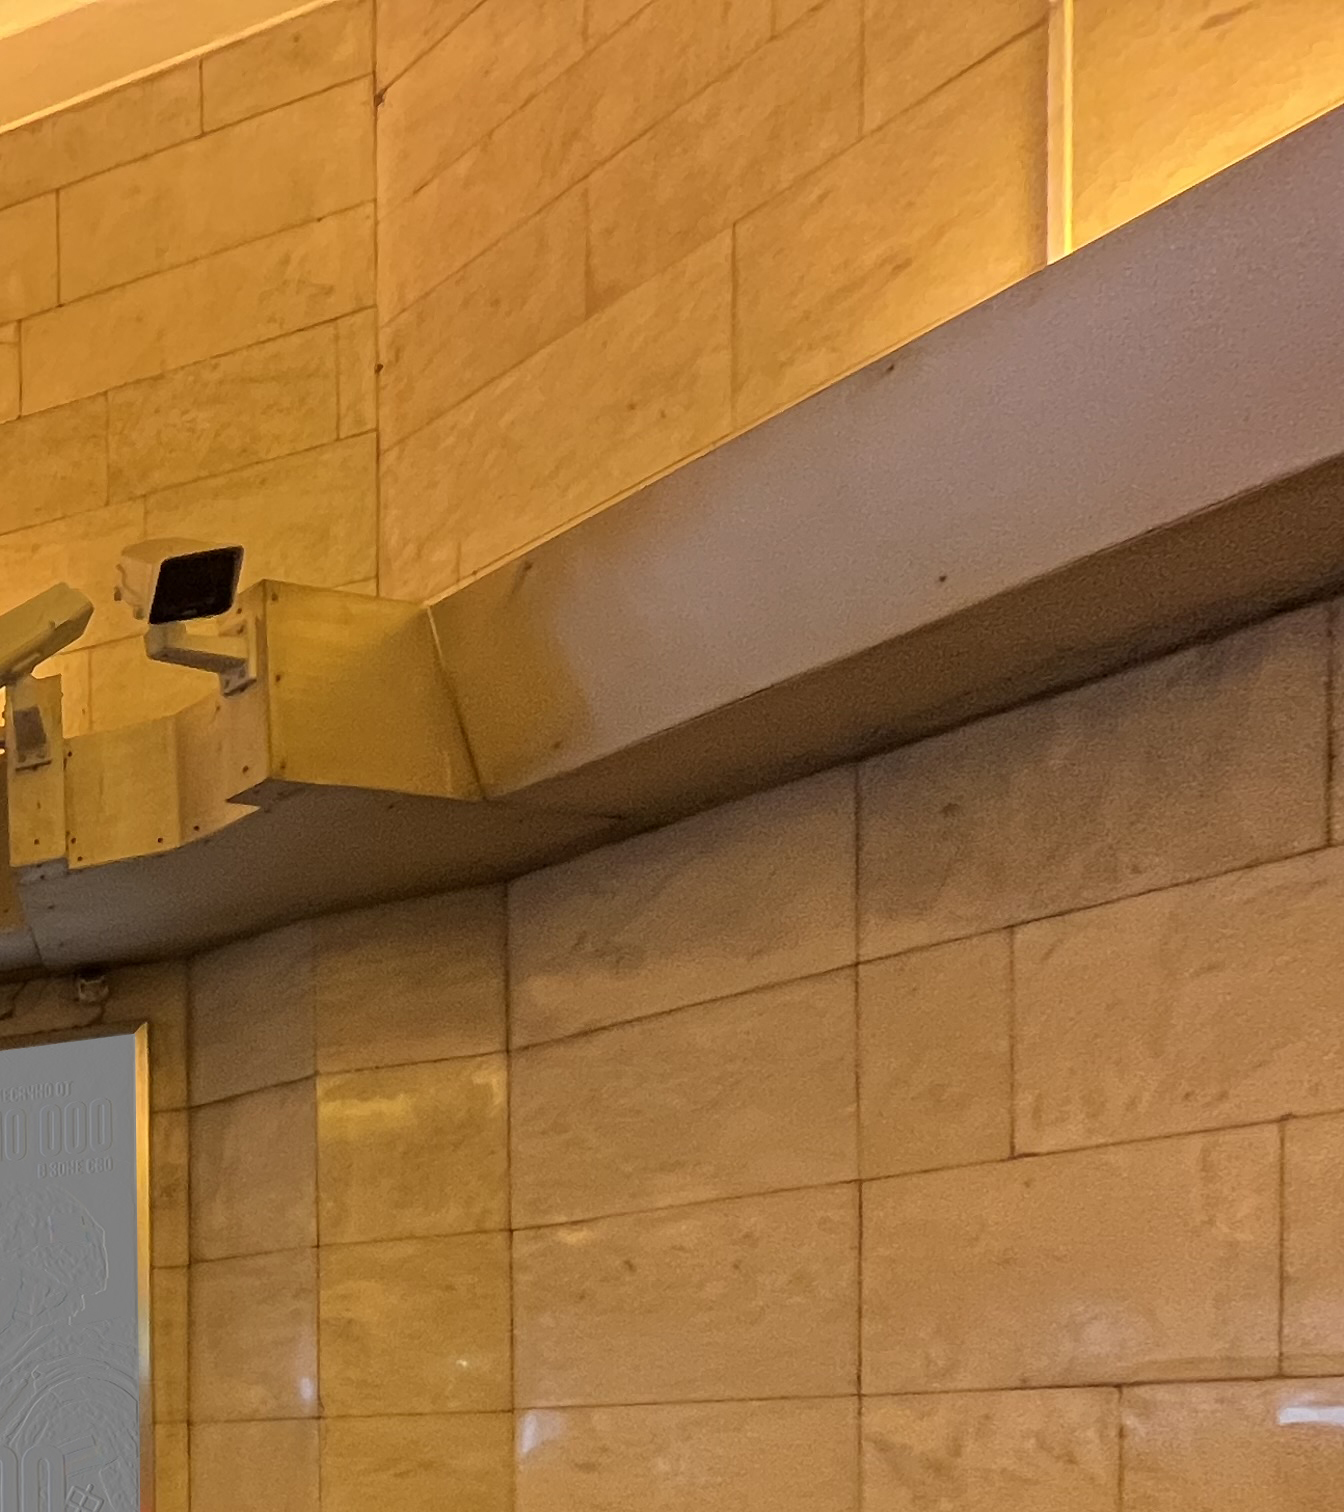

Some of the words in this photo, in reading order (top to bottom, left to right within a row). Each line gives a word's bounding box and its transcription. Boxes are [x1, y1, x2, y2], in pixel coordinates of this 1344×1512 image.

[55, 1080, 74, 1098] ОТ
[39, 1097, 113, 1159] 000
[37, 1162, 48, 1179] В
[49, 1159, 84, 1178] ЗОНЕ
[85, 1156, 114, 1175] СВО
